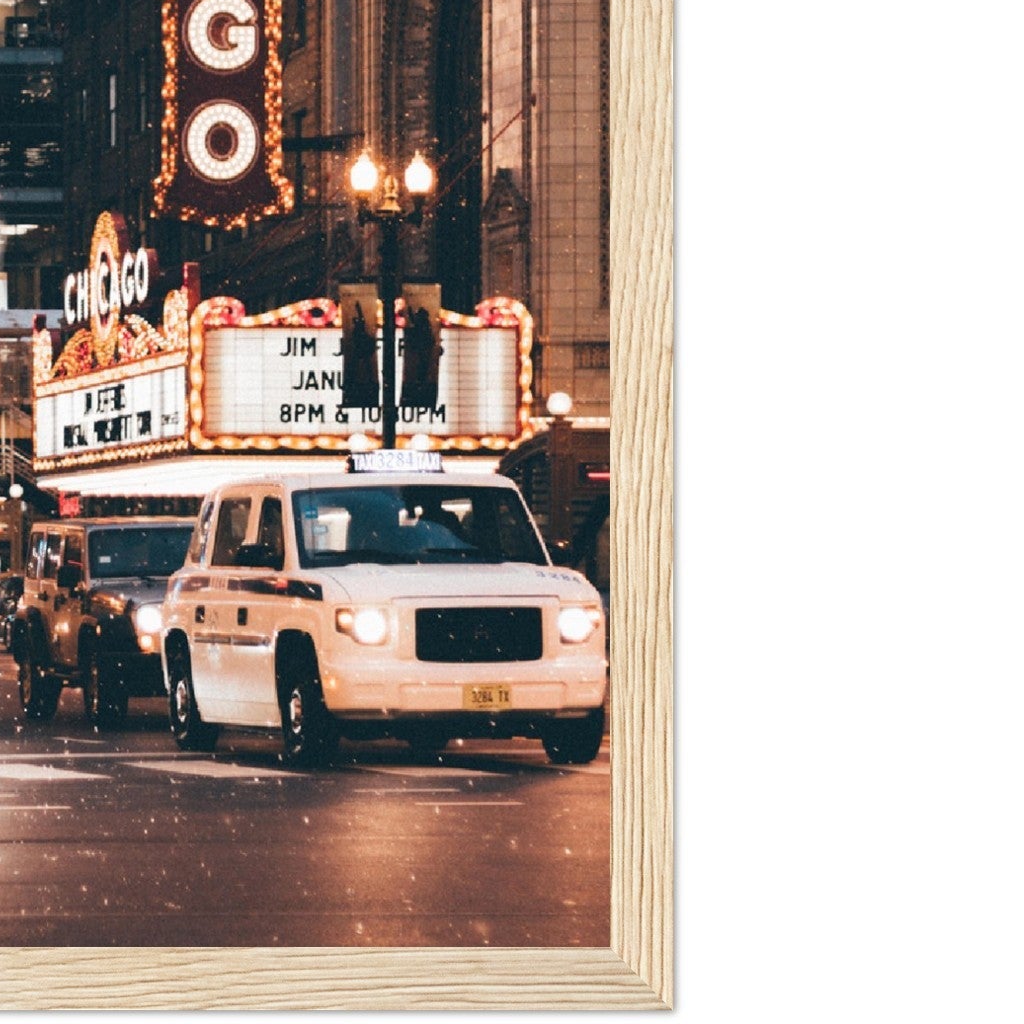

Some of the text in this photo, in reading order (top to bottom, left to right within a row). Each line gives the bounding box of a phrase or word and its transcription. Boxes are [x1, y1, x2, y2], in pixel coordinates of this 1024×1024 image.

[64, 246, 149, 325] CHICAGO
[280, 337, 317, 356] JIM
[280, 404, 325, 423] 8PM
[335, 406, 349, 423] &
[378, 452, 414, 469] 3284
